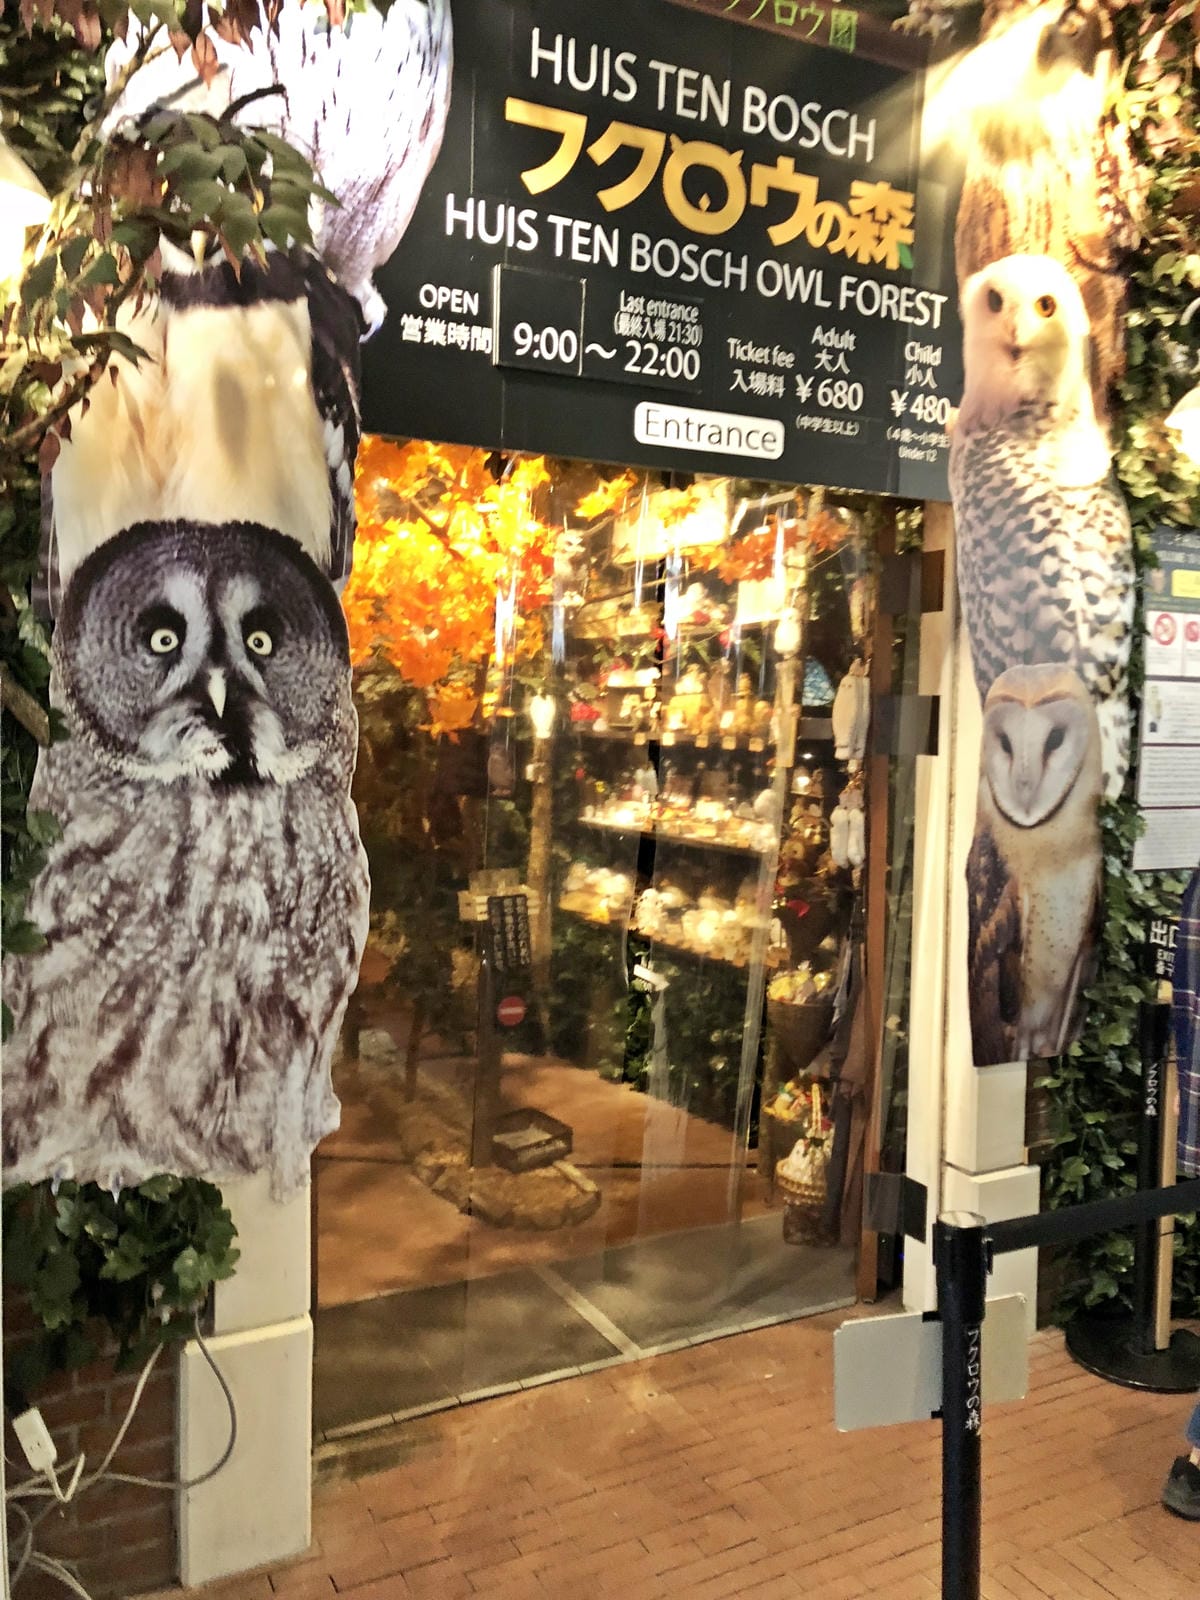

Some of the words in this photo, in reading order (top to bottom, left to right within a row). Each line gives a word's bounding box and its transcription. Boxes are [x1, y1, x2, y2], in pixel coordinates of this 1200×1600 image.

[530, 27, 638, 102] HUIS
[649, 60, 731, 127] TEN
[742, 86, 876, 162] BOSCH
[505, 96, 914, 270] フクロウの森
[445, 192, 539, 251] HUIS
[547, 214, 619, 267] TEN
[630, 233, 748, 292] BOSCH
[756, 259, 832, 308] OWL
[839, 275, 949, 329] FOREST
[419, 283, 479, 316] OPEN
[620, 289, 645, 315] Last
[647, 299, 699, 323] entrance
[400, 313, 493, 354] 営業時間
[811, 325, 857, 352] Adult
[513, 322, 577, 363] 9:00
[624, 339, 701, 380] 22:00
[727, 337, 770, 365] Ticket
[772, 344, 796, 369] fee
[814, 350, 850, 375] 大人
[905, 341, 942, 367] Child
[729, 368, 786, 398] 入場料
[905, 365, 938, 389] 小人
[646, 408, 777, 453] Entrance
[926, 449, 938, 462] 12
[966, 1329, 981, 1431] フクロウの森
